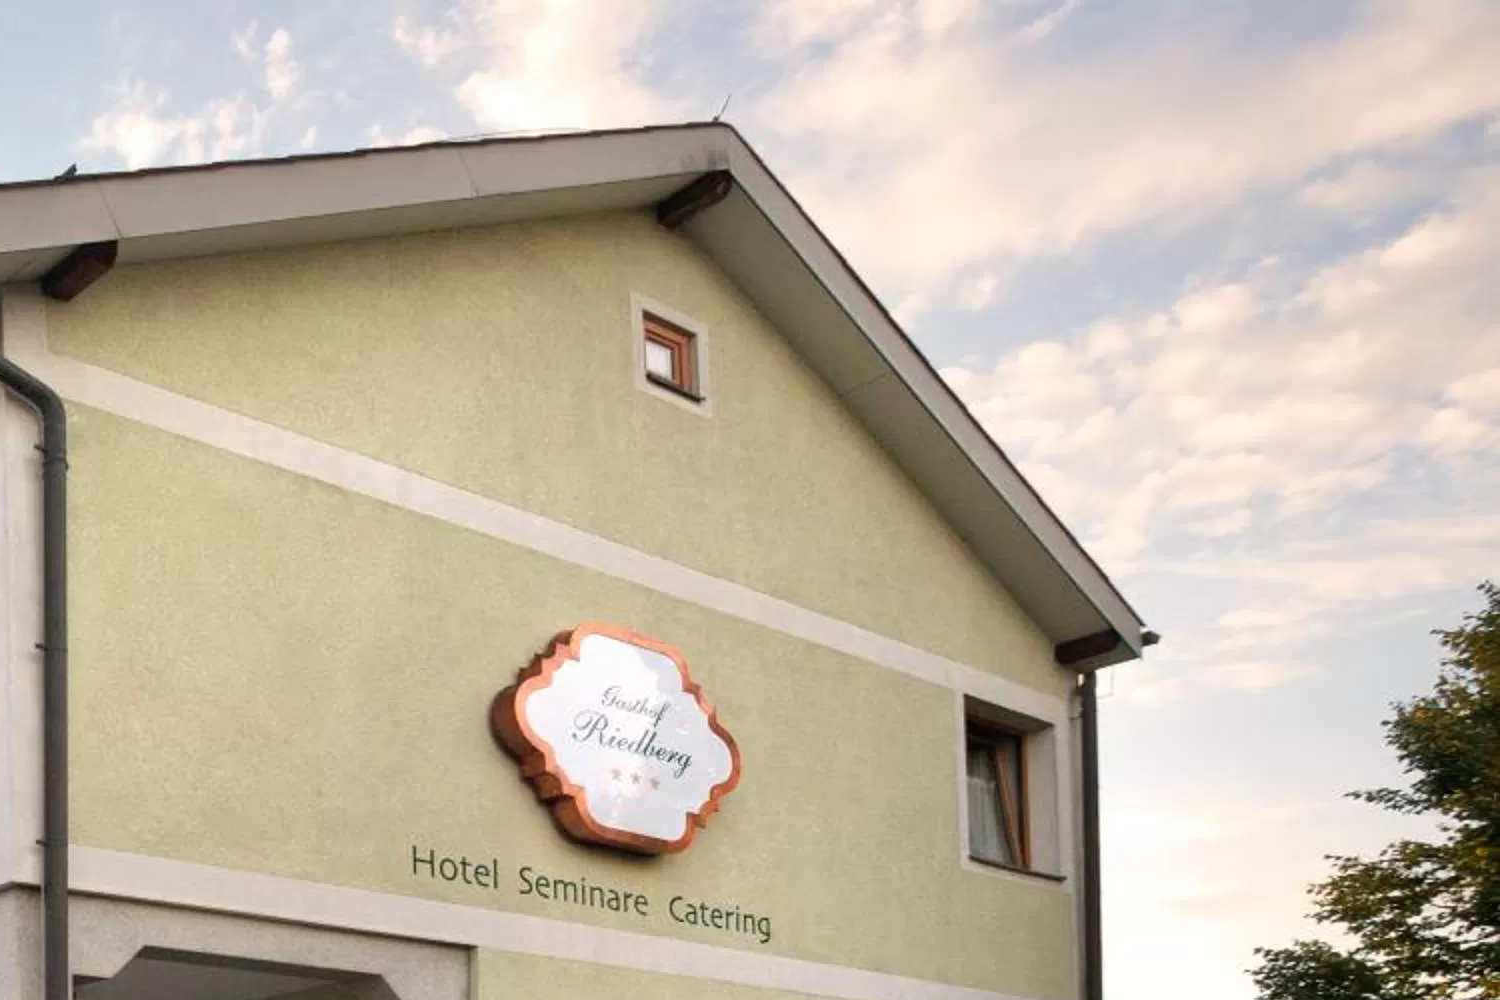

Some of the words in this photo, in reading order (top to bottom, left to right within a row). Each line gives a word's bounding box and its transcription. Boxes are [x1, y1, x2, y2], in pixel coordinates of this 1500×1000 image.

[600, 684, 672, 728] Gasthof
[571, 708, 693, 779] Riedberg
[411, 844, 499, 890] Hotel
[518, 866, 650, 917] Seminare
[668, 895, 773, 944] Catering
